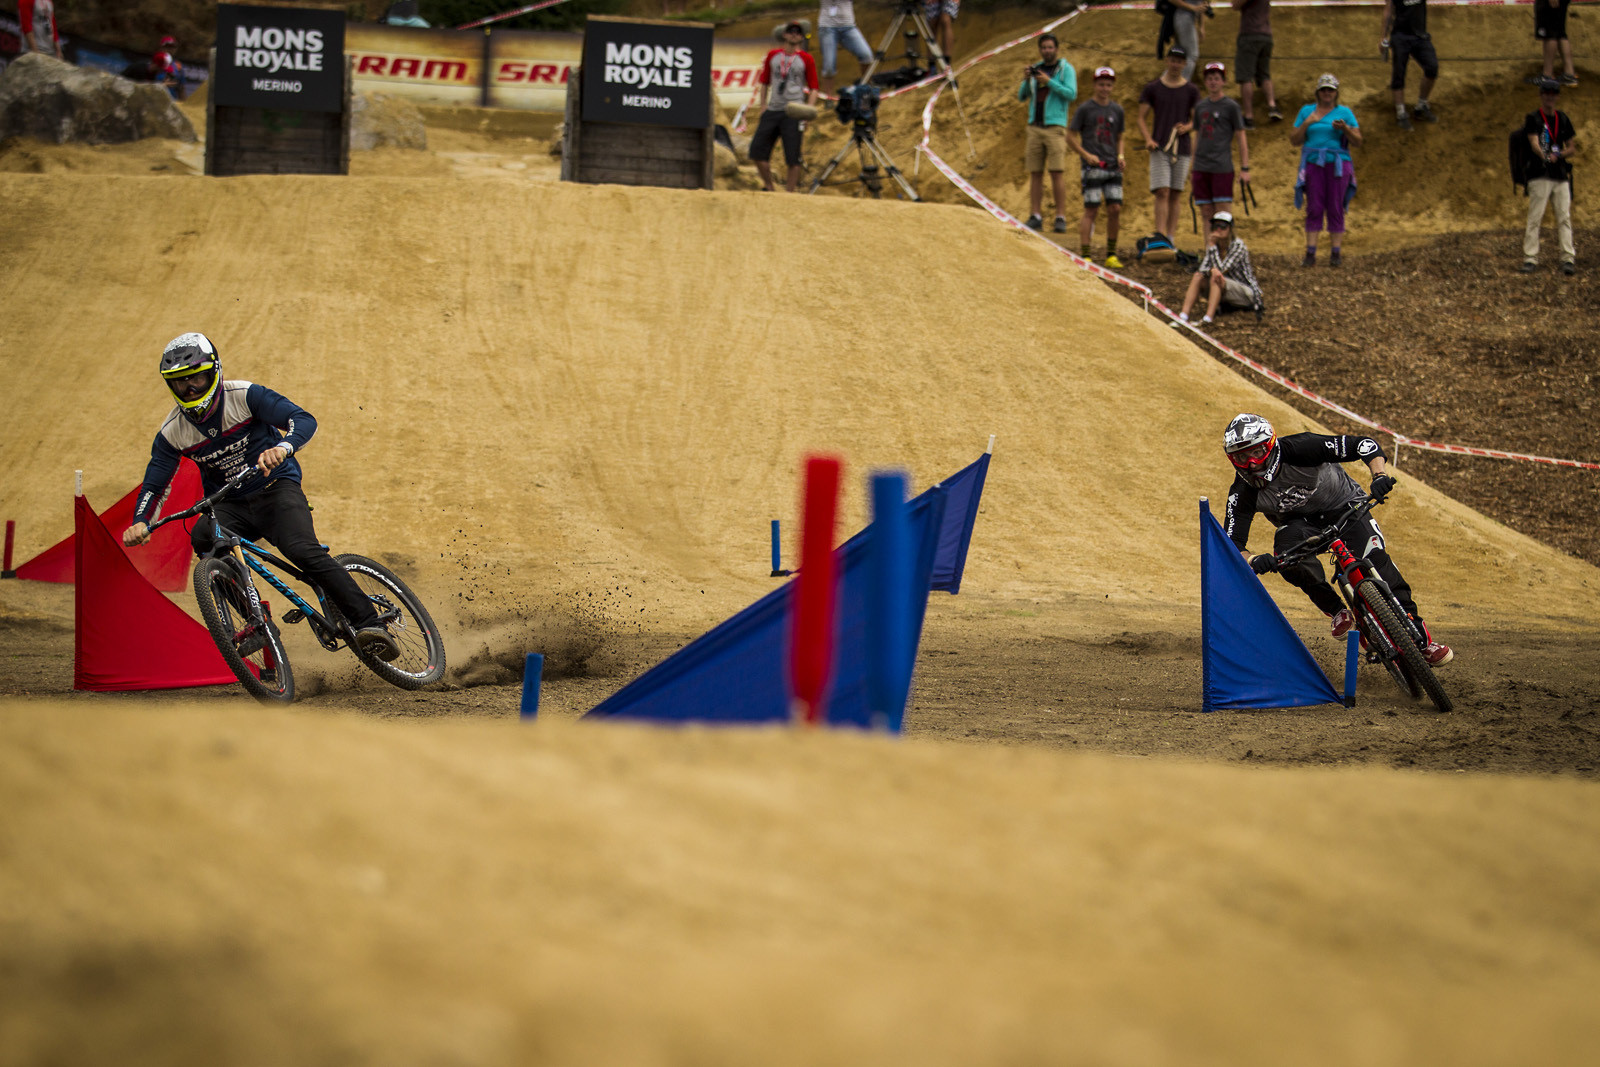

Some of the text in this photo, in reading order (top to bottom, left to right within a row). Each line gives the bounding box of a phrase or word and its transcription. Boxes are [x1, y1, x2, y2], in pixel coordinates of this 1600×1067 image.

[235, 26, 324, 52] MONS
[234, 49, 324, 73] ROYALE
[352, 53, 468, 81] RAM
[605, 41, 693, 69] MONS
[252, 78, 303, 93] MERINO
[603, 64, 693, 89] ROYALE
[622, 94, 672, 109] MERINO
